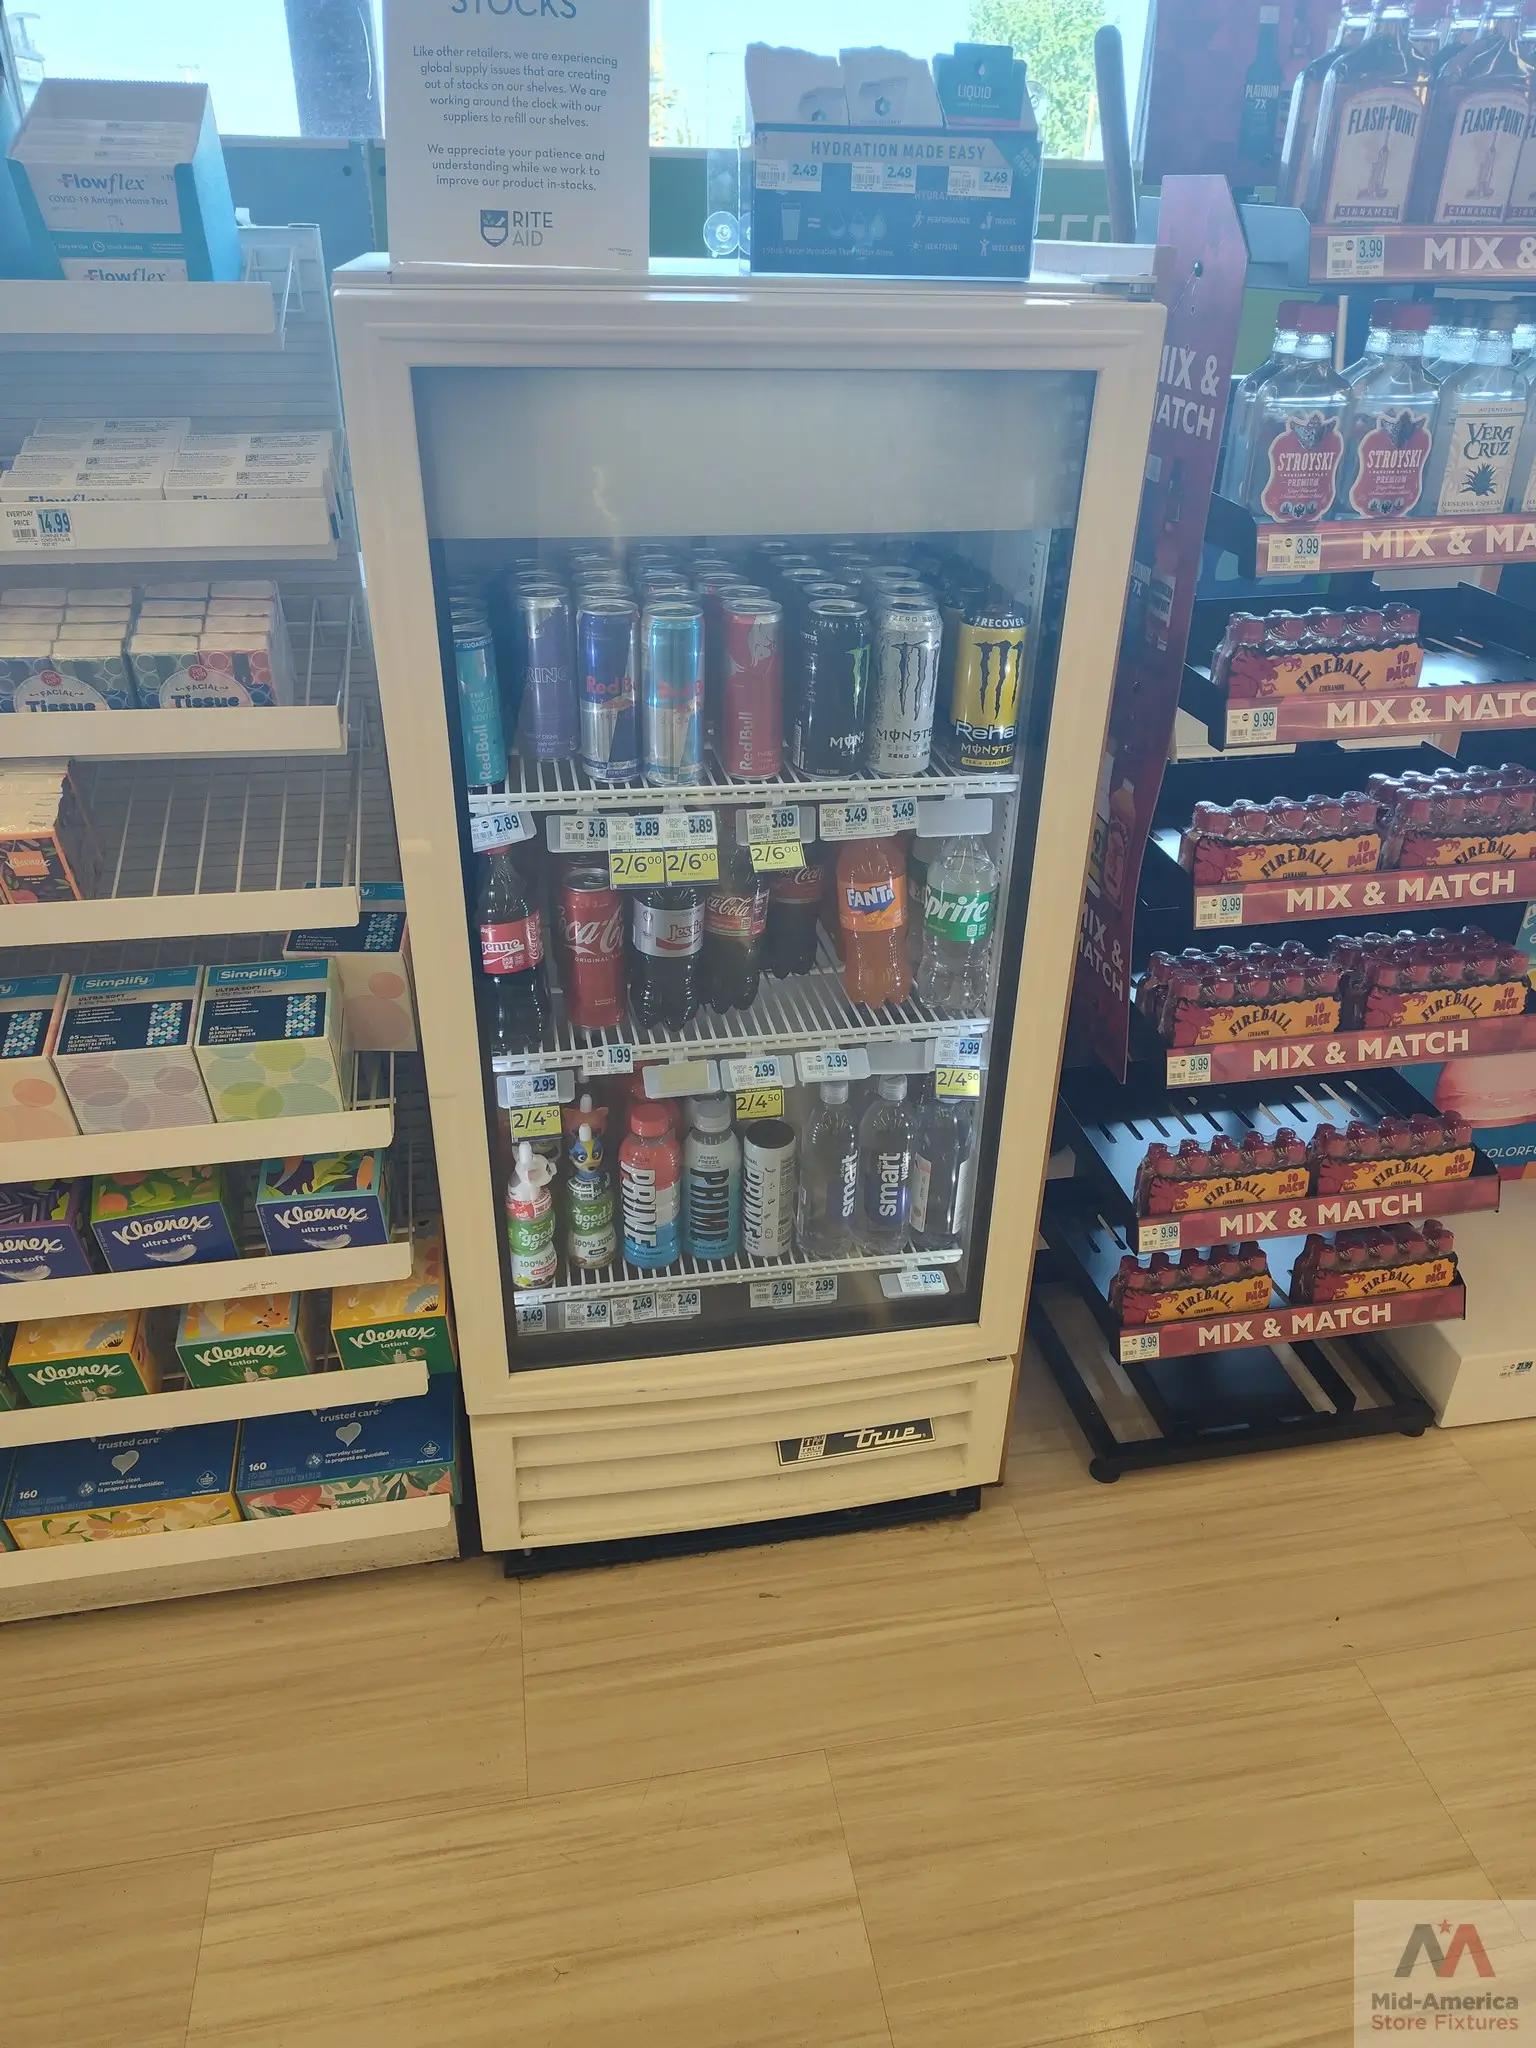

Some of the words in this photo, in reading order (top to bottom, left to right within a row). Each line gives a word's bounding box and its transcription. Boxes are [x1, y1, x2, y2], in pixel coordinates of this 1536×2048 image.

[450, 0, 577, 19] STOCKS
[413, 46, 434, 57] Like
[436, 46, 464, 57] other
[466, 47, 512, 60] retailers,
[514, 51, 528, 59] we
[531, 52, 549, 61] are
[551, 52, 618, 69] experiencing
[420, 62, 452, 75] global
[454, 63, 487, 76] supply
[490, 63, 520, 75] issues
[523, 66, 545, 77] that
[547, 69, 564, 78] are
[567, 68, 610, 84] creating
[424, 79, 442, 89] out
[443, 78, 454, 89] of
[456, 78, 488, 91] stocks
[491, 82, 504, 91] on
[507, 83, 524, 92] our
[526, 80, 566, 94] shelves.
[569, 84, 586, 95] We
[589, 87, 606, 97] are
[957, 84, 992, 100] LIQUID
[1245, 84, 1279, 98] PLATINUM
[430, 94, 470, 108] working
[472, 96, 509, 108] around
[512, 97, 528, 108] the
[531, 97, 557, 109] clock
[560, 99, 581, 111] with
[584, 103, 602, 113] our
[443, 111, 488, 124] suppliers
[491, 112, 500, 123] to
[504, 112, 526, 124] refill
[529, 116, 545, 125] our
[549, 115, 588, 127] shelves.
[427, 144, 444, 154] We
[447, 145, 505, 158] appreciate
[508, 149, 532, 159] your
[535, 147, 582, 160] patience
[585, 151, 605, 161] and
[811, 140, 898, 158] HYDRATION
[901, 144, 944, 159] MADE
[949, 146, 986, 160] EASY
[432, 160, 509, 174] understanding
[512, 161, 540, 173] while
[542, 165, 557, 174] we
[560, 164, 586, 175] work
[589, 167, 600, 176] to
[792, 163, 818, 177] 2.49
[887, 166, 912, 180] 2.49
[60, 172, 146, 194] Flowflex
[436, 174, 479, 187] improve
[482, 178, 499, 187] our
[502, 177, 544, 190] product
[547, 178, 597, 191] in-stocks.
[984, 171, 1008, 184] 2.49
[91, 196, 124, 206] Antigen
[125, 197, 149, 206] Home
[151, 197, 168, 206] Test
[512, 211, 553, 228] RITE
[1339, 207, 1395, 218] CINNAMON
[1448, 206, 1497, 217] CINNAMON
[512, 231, 544, 247] AID
[1359, 239, 1383, 259] 3.99
[1424, 237, 1504, 271] MIX
[1200, 355, 1221, 398] &
[1466, 422, 1516, 441] VERA
[1463, 440, 1511, 460] CRUZ
[1277, 452, 1336, 472] STROYSKI
[1366, 449, 1423, 469] STROYSKI
[6, 510, 33, 518] EVERYDAY
[37, 512, 71, 533] 14.99
[1296, 537, 1319, 555] 3.99
[1362, 528, 1437, 561] MIX
[1447, 527, 1473, 556] &
[980, 617, 1025, 628] RECOVER
[1396, 650, 1410, 665] 10
[1296, 653, 1374, 692] FIREBALL
[1386, 662, 1417, 682] PACK
[25, 700, 96, 712] Tissue
[170, 695, 240, 708] Tissue
[1253, 711, 1275, 727] 9.99
[1326, 698, 1397, 729] MIX
[1408, 697, 1432, 724] &
[844, 807, 868, 823] 3.49
[892, 802, 914, 819] 3.49
[494, 815, 519, 833] 2.89
[635, 821, 660, 836] 3.89
[688, 819, 713, 834] 3.89
[771, 813, 795, 828] 3.89
[1259, 846, 1334, 878] FIREBALL
[1347, 849, 1377, 869] PACK
[846, 885, 895, 908] FANTA
[1286, 881, 1353, 913] MIX
[1363, 880, 1386, 906] &
[1398, 869, 1516, 904] MATCH
[1221, 896, 1241, 912] 9.99
[86, 975, 149, 988] Simplify
[220, 967, 282, 980] Simplify
[1420, 991, 1482, 1022] FIREBALL
[1494, 996, 1519, 1011] PACK
[1229, 1007, 1293, 1038] FIREBALL
[1305, 1012, 1331, 1029] PACK
[608, 1048, 631, 1064] 1.99
[959, 1042, 980, 1055] 2.99
[1253, 1043, 1317, 1073] MIX
[1324, 1040, 1347, 1064] &
[1352, 1028, 1470, 1060] MATCH
[827, 1053, 848, 1068] 2.99
[1189, 1056, 1209, 1072] 9.99
[754, 1063, 775, 1078] 2.99
[533, 1077, 556, 1093] 2.99
[900, 1151, 912, 1181] water
[1371, 1160, 1433, 1187] FIREBALL
[1444, 1162, 1472, 1177] PACK
[842, 1149, 858, 1217] smart
[878, 1152, 901, 1217] smart
[1278, 1180, 1306, 1195] PACK
[1203, 1178, 1266, 1207] FIREBALL
[621, 1160, 657, 1248] PRIME
[274, 1206, 369, 1229] Kleenex
[1219, 1210, 1280, 1238] MIX
[1287, 1206, 1307, 1228] &
[1317, 1193, 1423, 1225] MATCH
[111, 1215, 213, 1246] Kleenex
[301, 1225, 327, 1233] ultra
[1161, 1225, 1179, 1239] 9.99
[142, 1238, 169, 1249] ultra
[170, 1234, 192, 1244] soft
[1361, 1270, 1415, 1296] FIREBALL
[1425, 1271, 1447, 1285] PACK
[1175, 1286, 1232, 1316] FIREBALL
[1245, 1288, 1270, 1303] PACK
[1198, 1321, 1254, 1348] MIX
[1262, 1318, 1283, 1339] &
[1291, 1302, 1392, 1333] MATCH
[348, 1323, 437, 1350] Kleenex
[1140, 1336, 1158, 1350] 9.99
[195, 1344, 288, 1367] Kleenex
[28, 1363, 123, 1386] Kleenex
[319, 1410, 356, 1423] trusted
[357, 1408, 380, 1418] care
[98, 1438, 135, 1450] trusted
[137, 1436, 160, 1446] care
[249, 1462, 267, 1472] 160
[19, 1489, 38, 1500] 160
